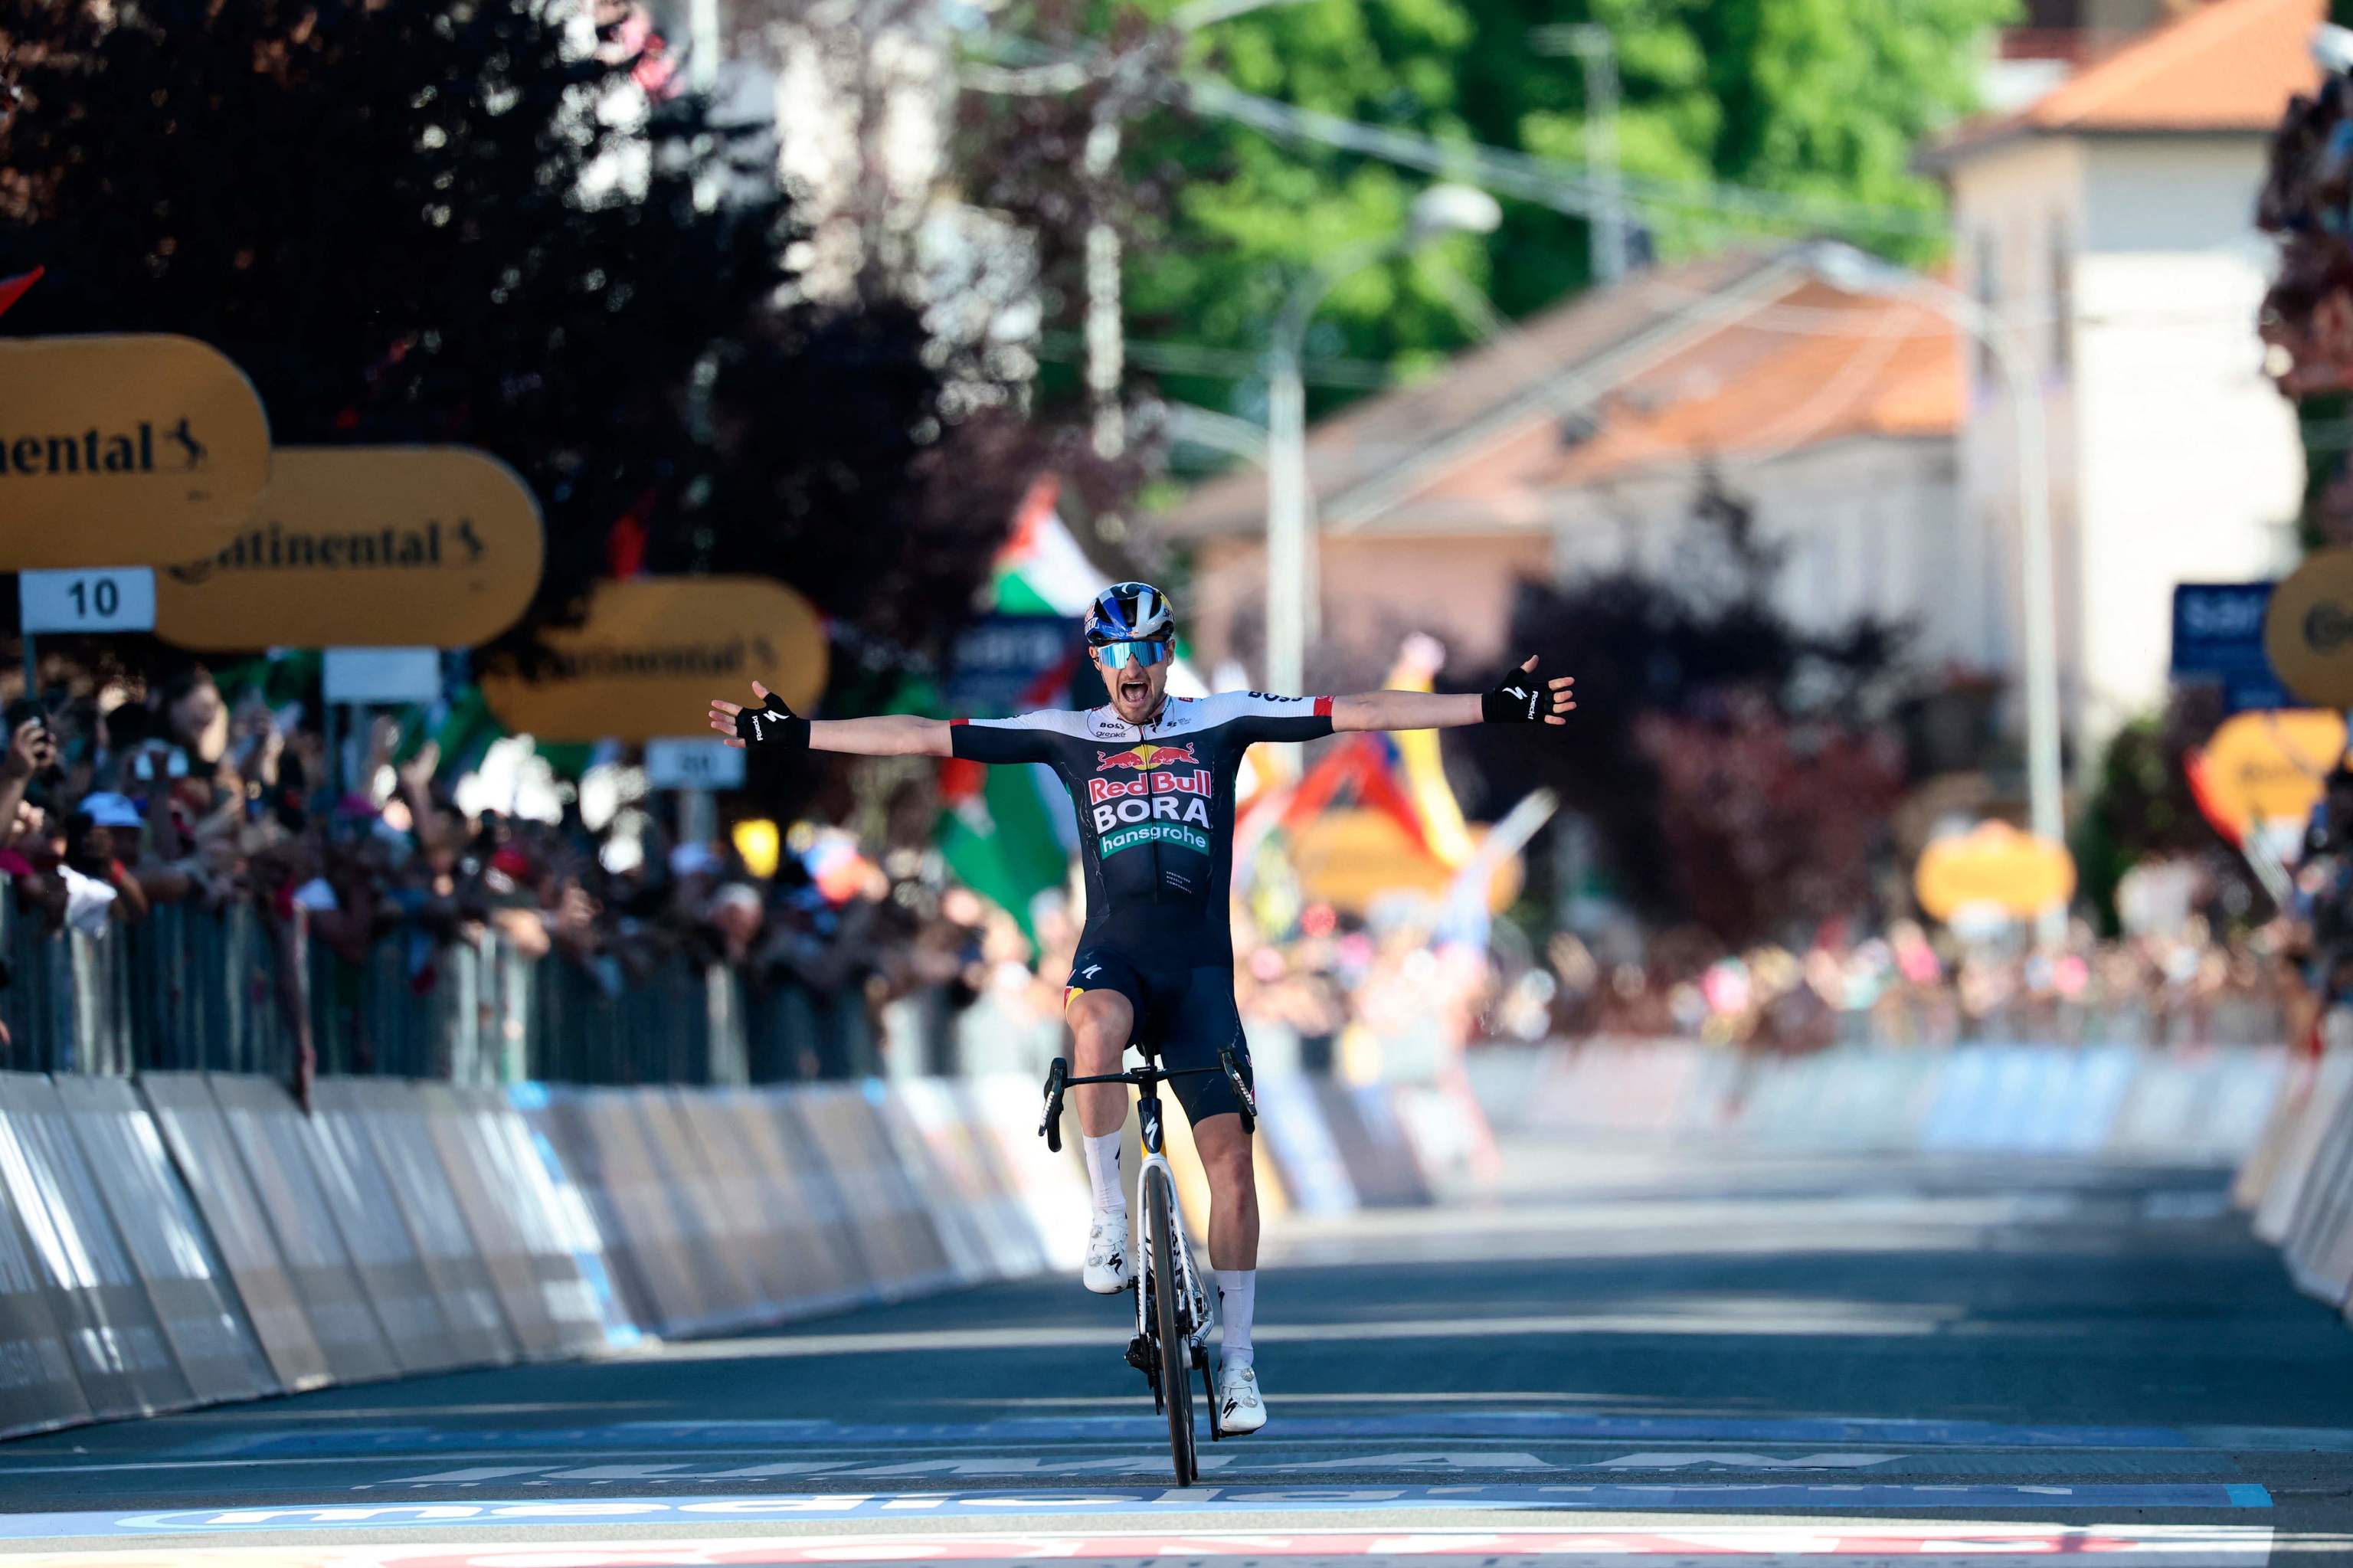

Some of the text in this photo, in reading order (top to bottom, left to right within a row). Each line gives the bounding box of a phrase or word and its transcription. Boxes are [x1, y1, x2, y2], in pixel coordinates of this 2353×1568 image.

[163, 519, 441, 584] ntinental
[66, 577, 120, 618] 10
[1088, 769, 1212, 805] Red Bull
[1093, 796, 1210, 835] BORA
[1101, 826, 1206, 853] hansgrohe
